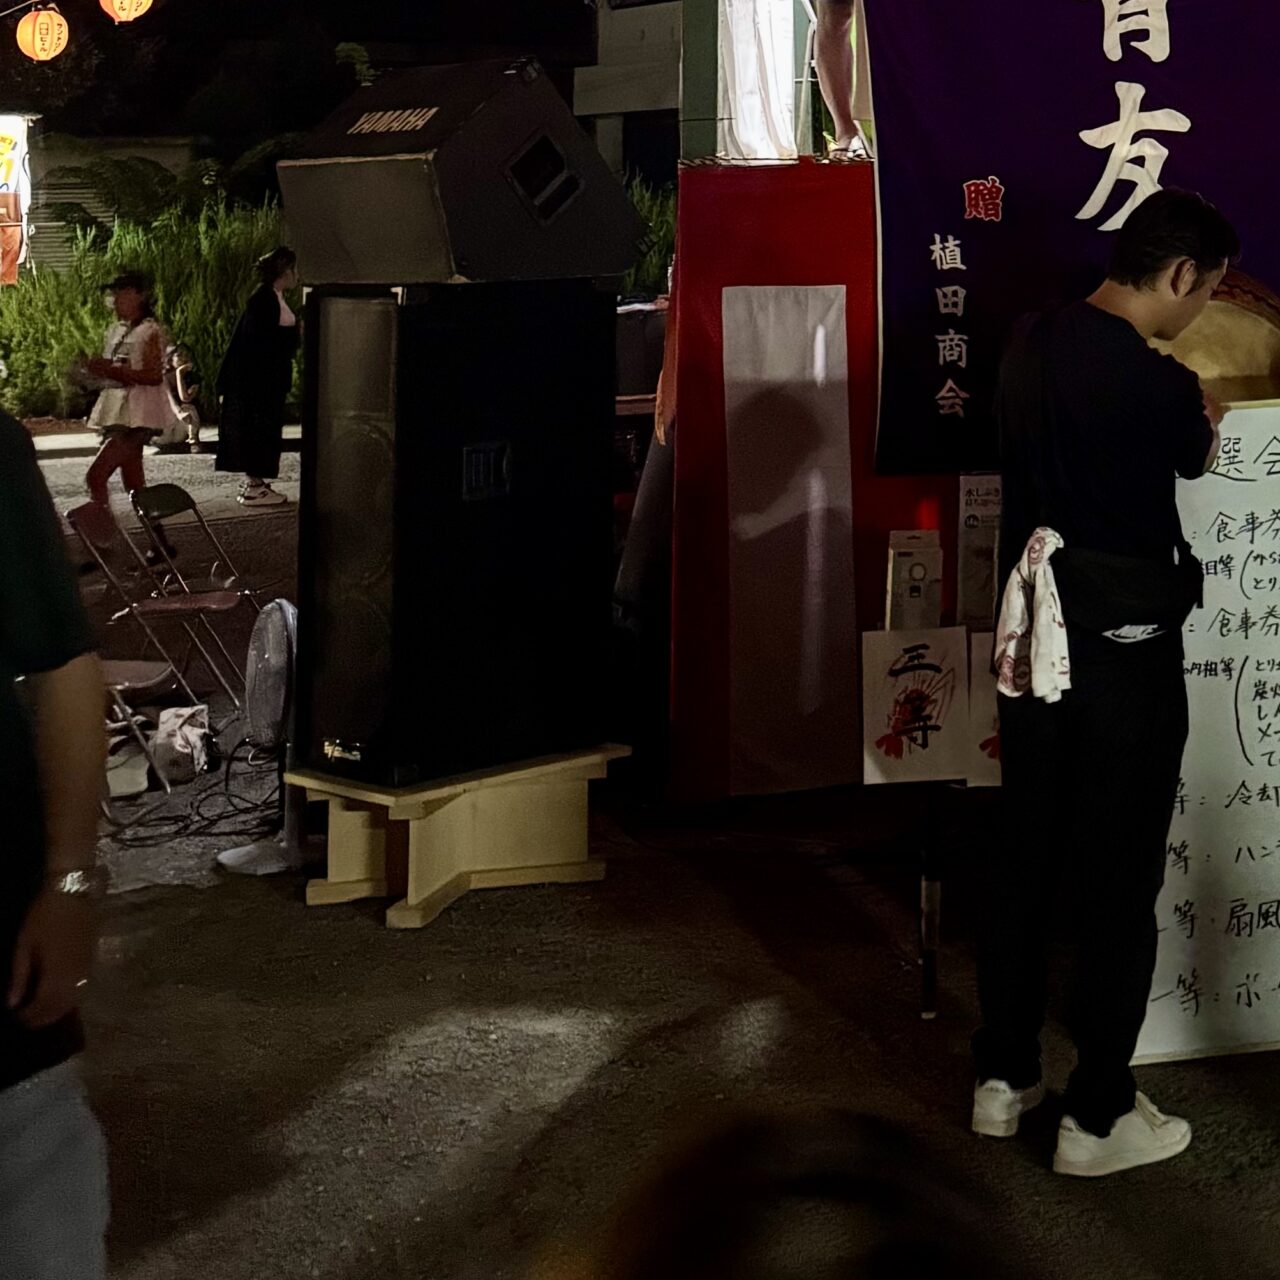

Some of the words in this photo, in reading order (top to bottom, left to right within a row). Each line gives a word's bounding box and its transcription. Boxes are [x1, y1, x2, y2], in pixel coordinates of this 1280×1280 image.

[346, 106, 440, 135] YAMAHA
[962, 175, 1005, 222] 贈
[929, 233, 970, 418] 植田商会
